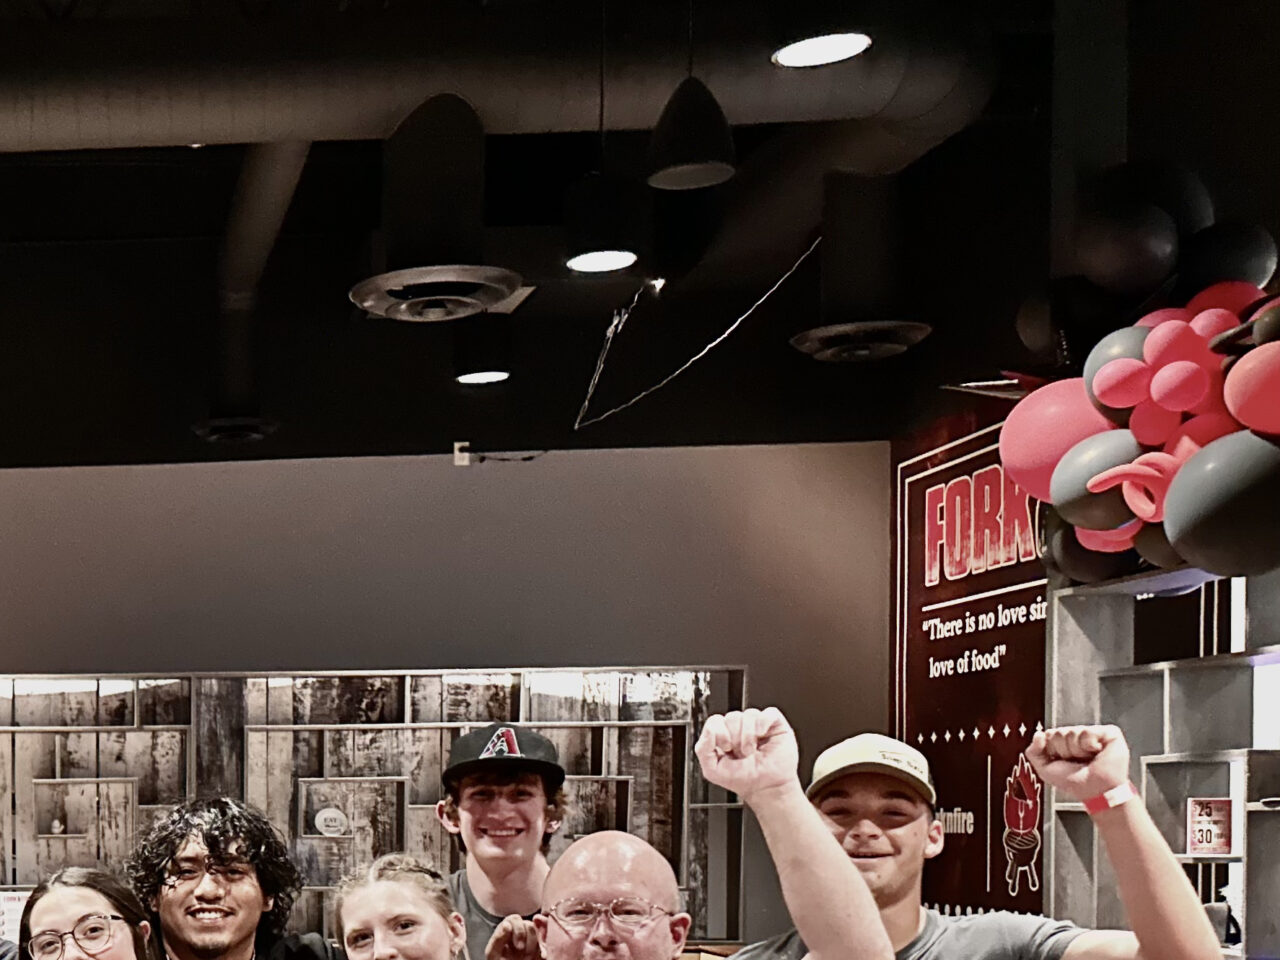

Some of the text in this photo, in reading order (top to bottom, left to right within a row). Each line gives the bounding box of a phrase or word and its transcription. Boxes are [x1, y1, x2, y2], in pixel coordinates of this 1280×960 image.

[925, 464, 1036, 587] FORK
[965, 612, 976, 633] is
[979, 616, 995, 632] no
[997, 604, 1027, 627] love
[929, 656, 954, 678] love
[957, 649, 969, 673] of
